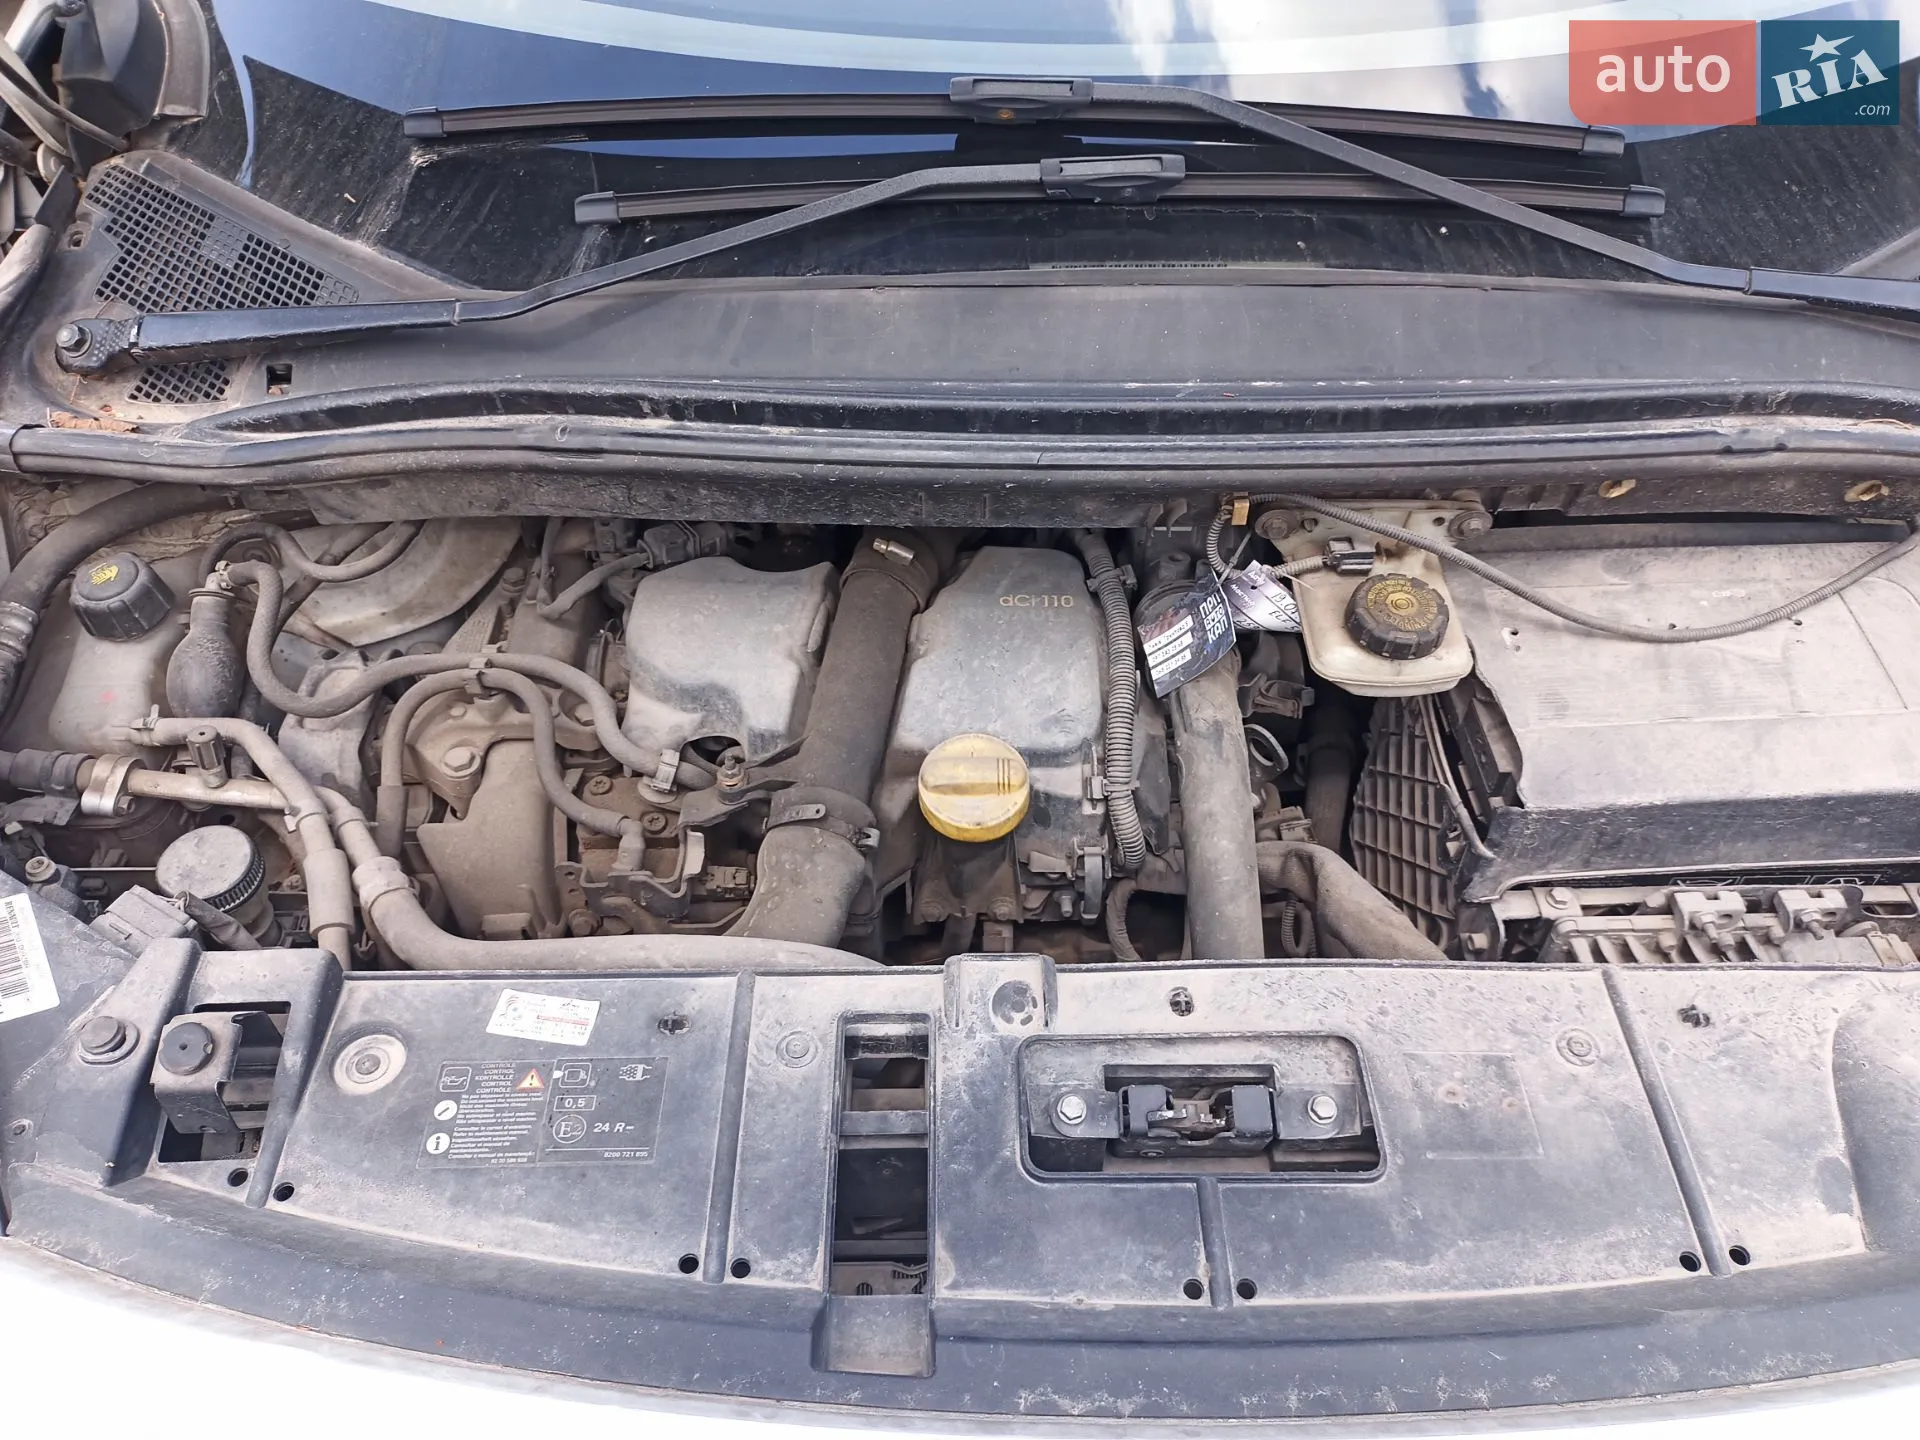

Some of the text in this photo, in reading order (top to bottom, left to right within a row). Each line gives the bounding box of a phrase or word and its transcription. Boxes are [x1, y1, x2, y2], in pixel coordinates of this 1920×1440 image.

[1041, 594, 1075, 608] 110
[564, 1097, 586, 1109] 0,5
[558, 1121, 583, 1138] E2
[593, 1122, 610, 1133] 24
